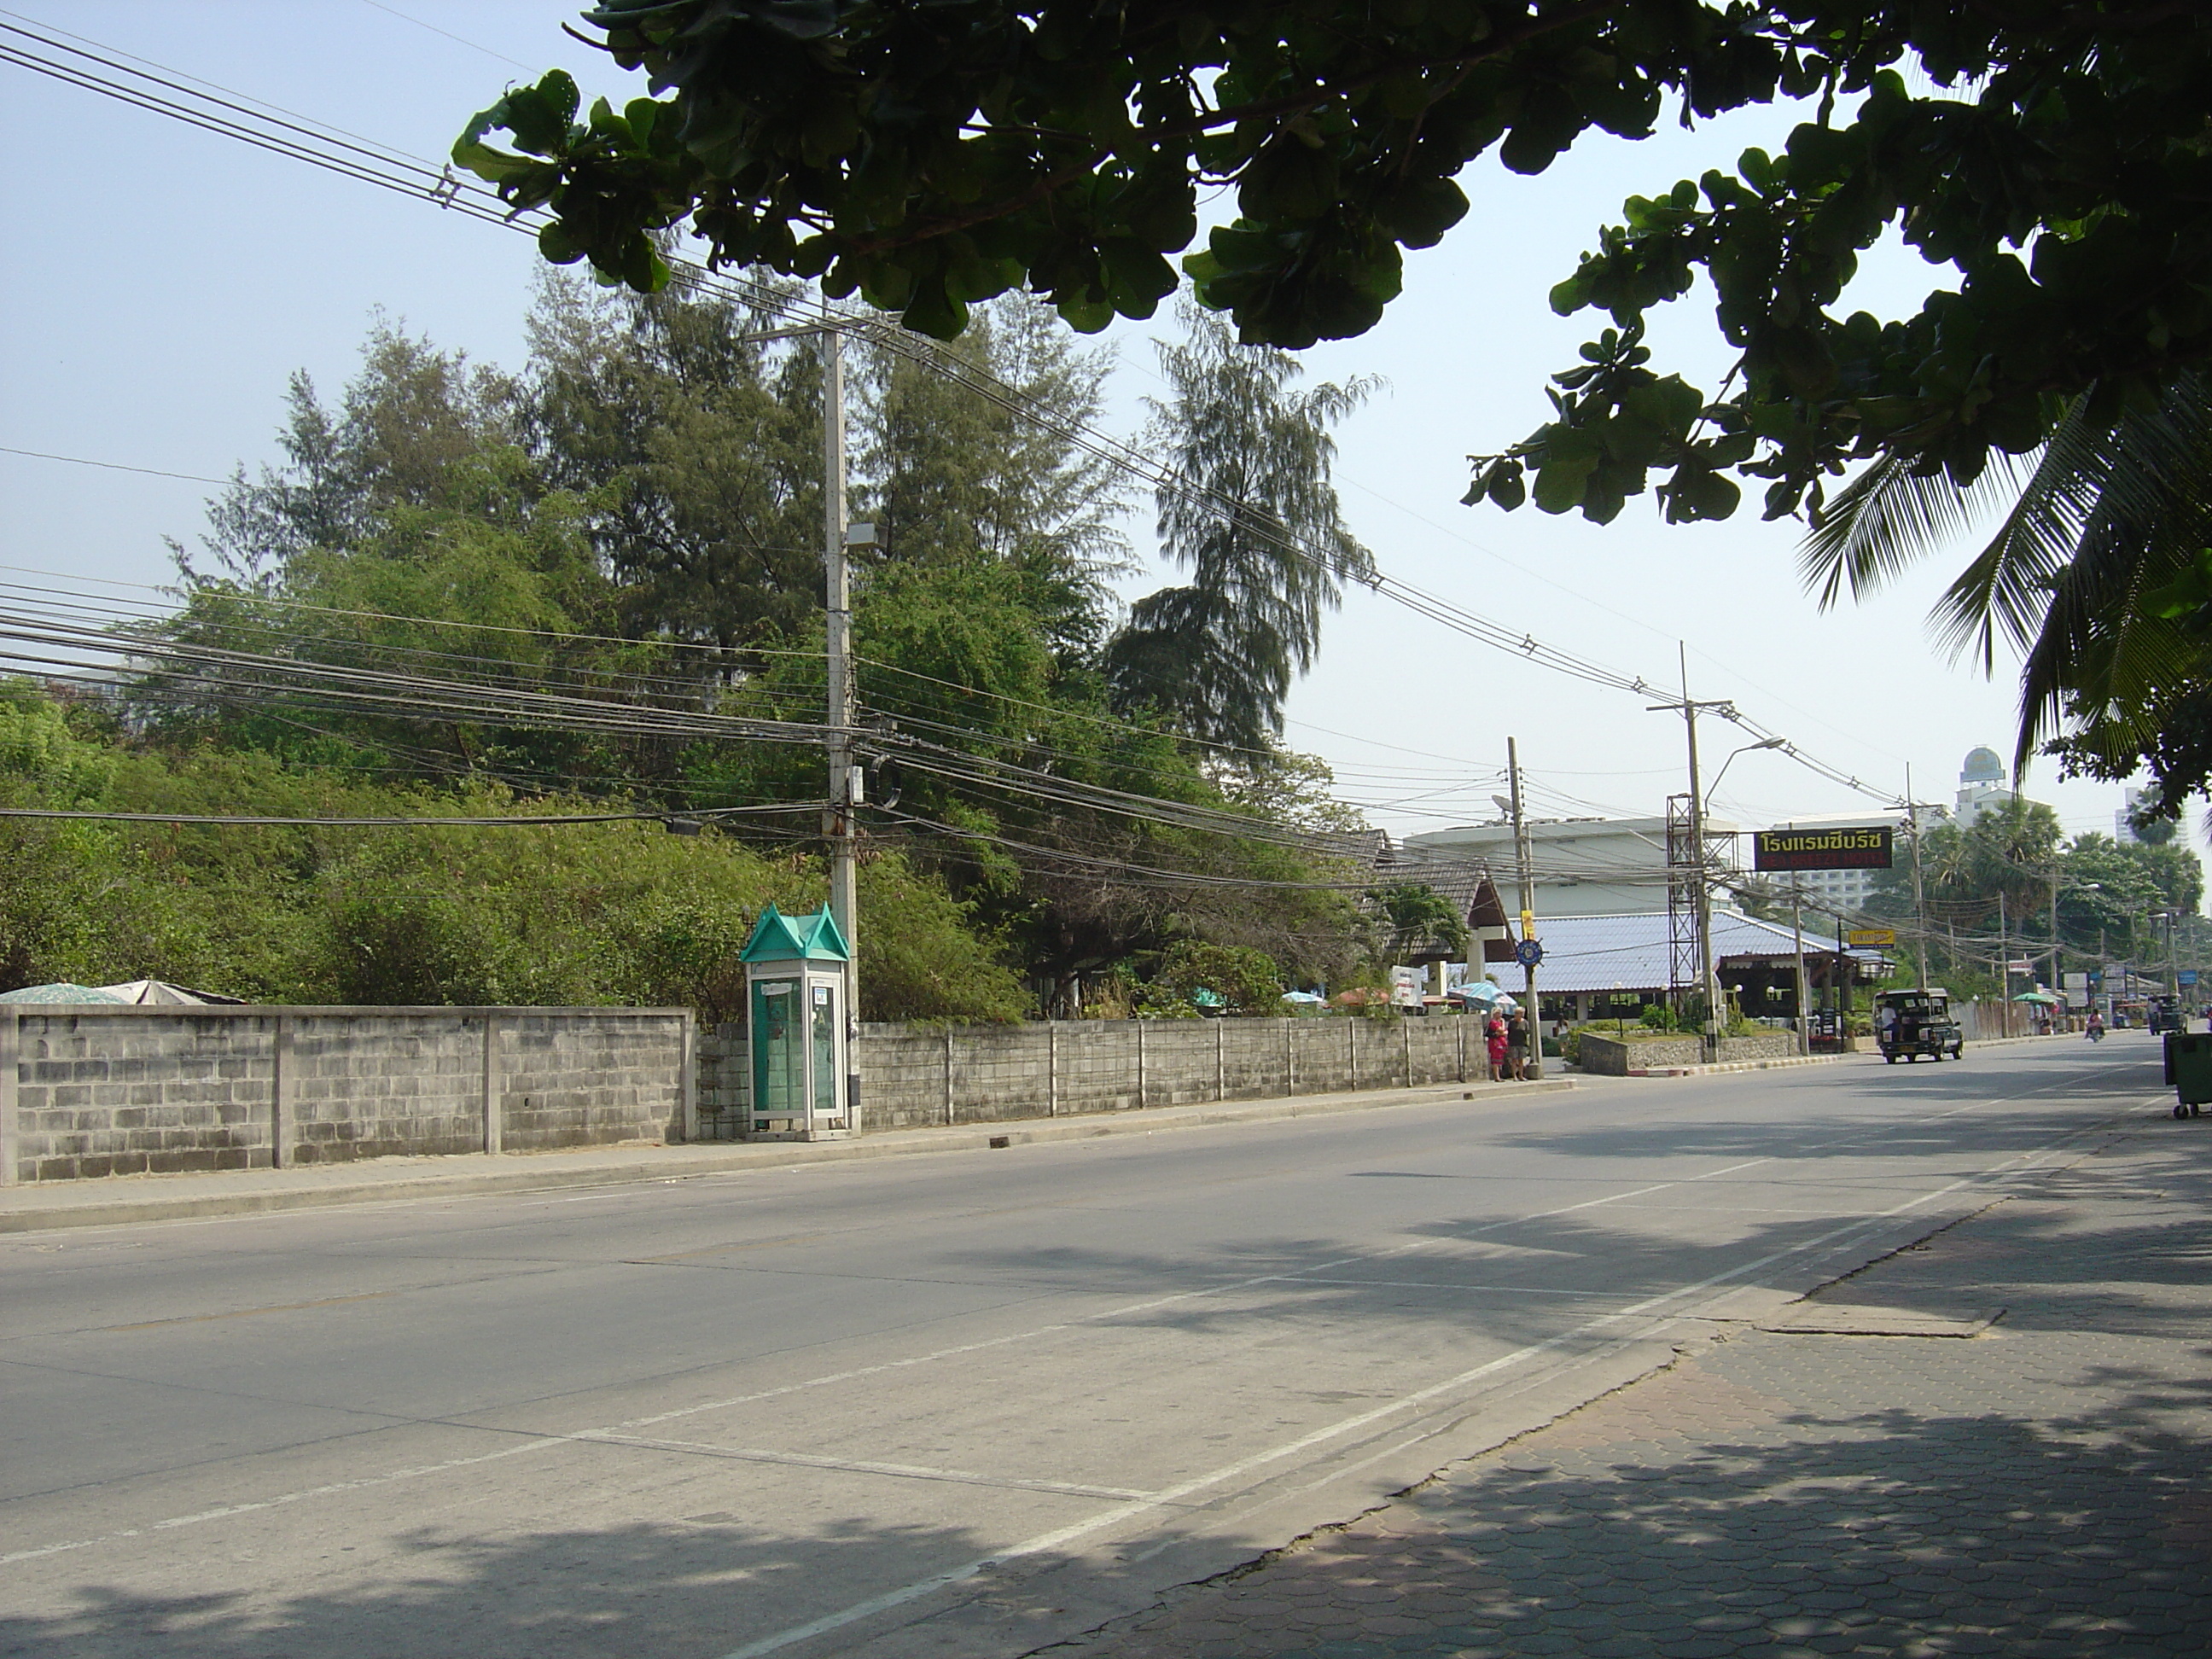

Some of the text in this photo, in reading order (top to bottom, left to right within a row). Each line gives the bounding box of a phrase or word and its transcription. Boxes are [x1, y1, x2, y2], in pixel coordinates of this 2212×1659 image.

[1761, 852, 1886, 867] SEA BREEZE HOTEL
